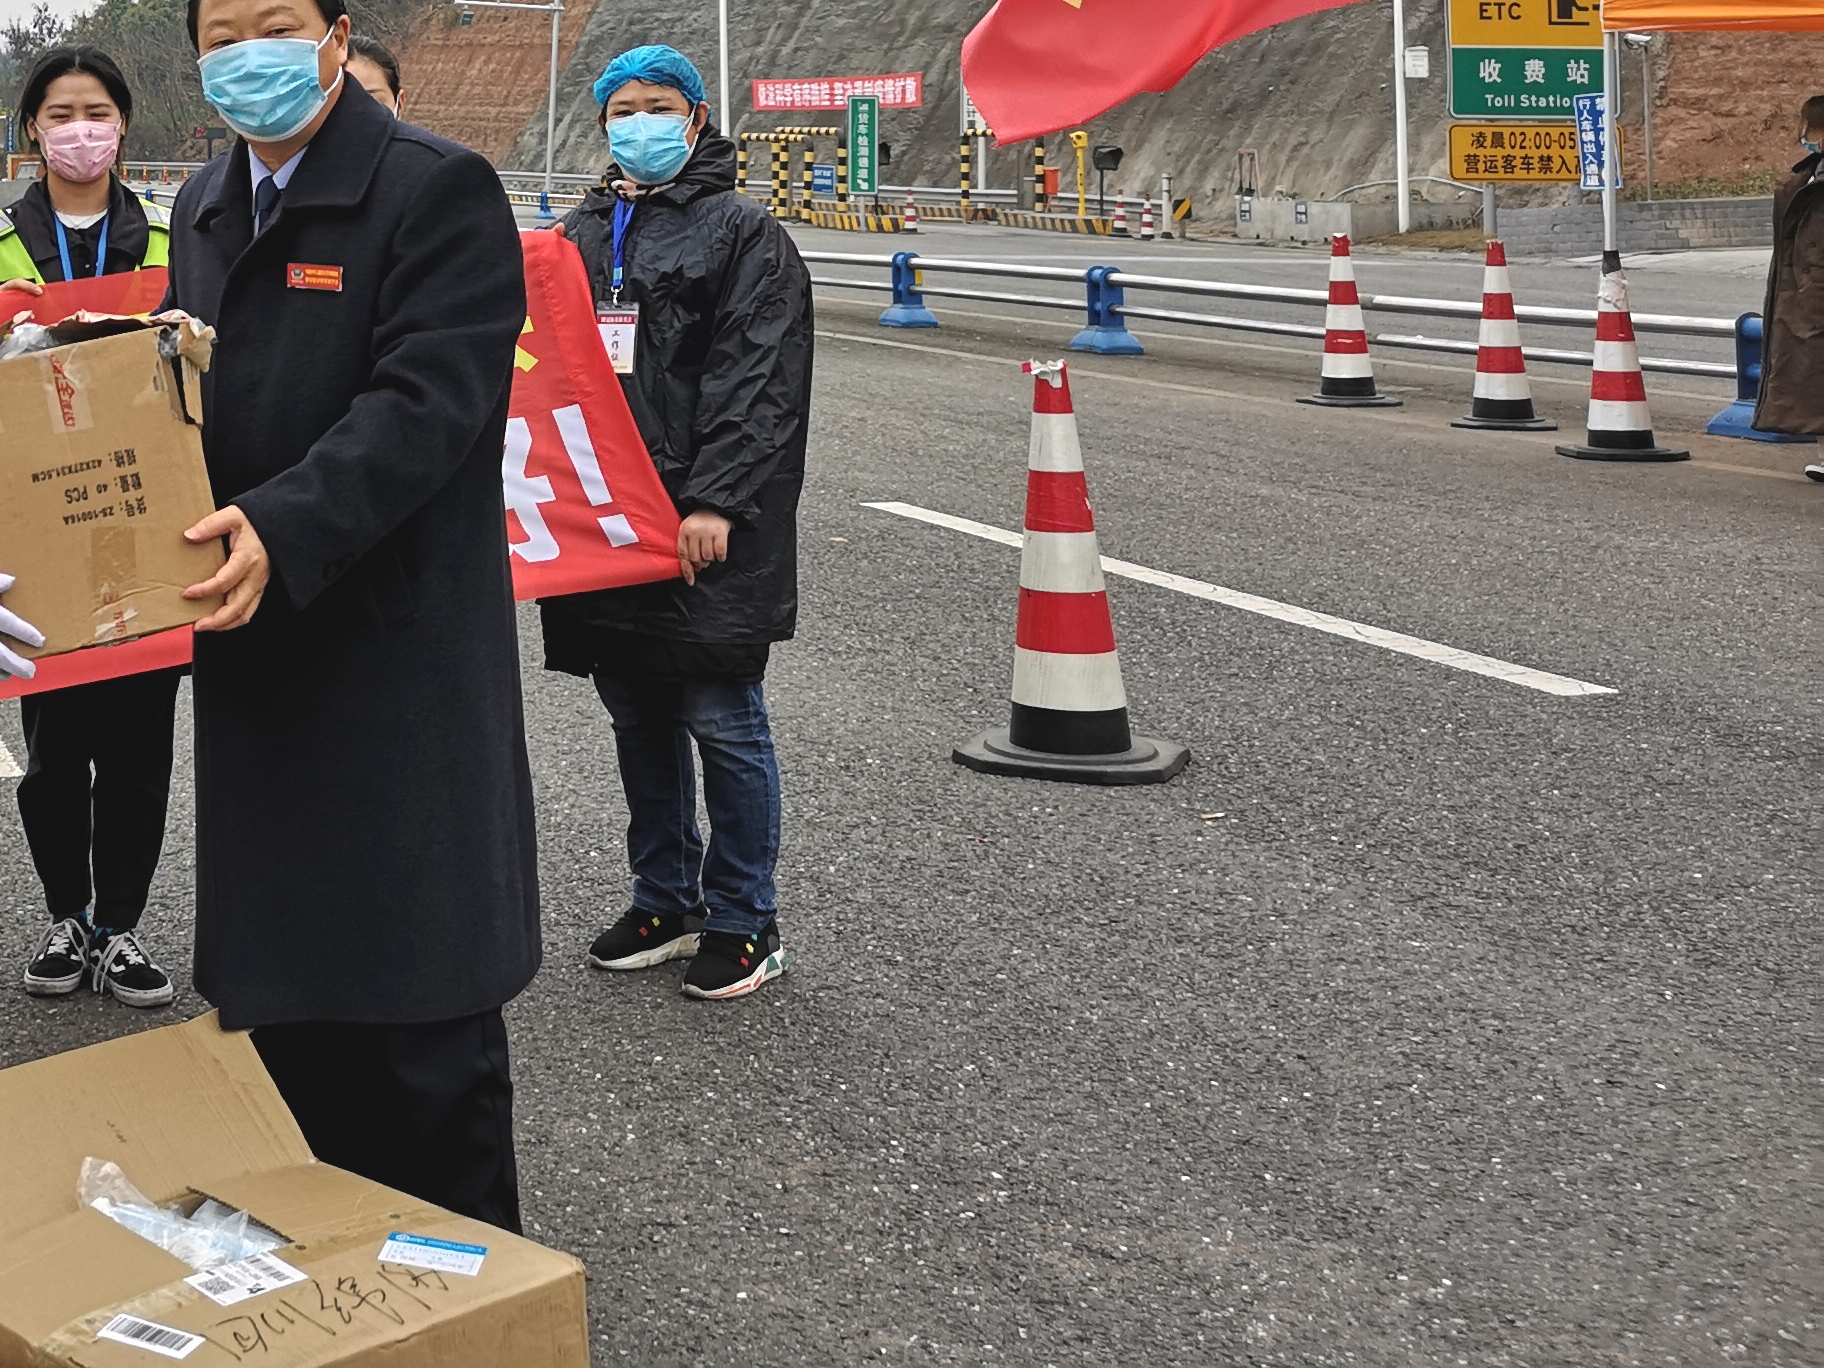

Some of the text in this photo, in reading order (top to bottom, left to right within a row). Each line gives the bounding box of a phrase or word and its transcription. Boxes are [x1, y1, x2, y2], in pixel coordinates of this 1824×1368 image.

[1479, 2, 1522, 20] ETC
[1479, 59, 1590, 84] 收费站
[1485, 94, 1515, 107] Toll
[64, 486, 90, 505] PCS
